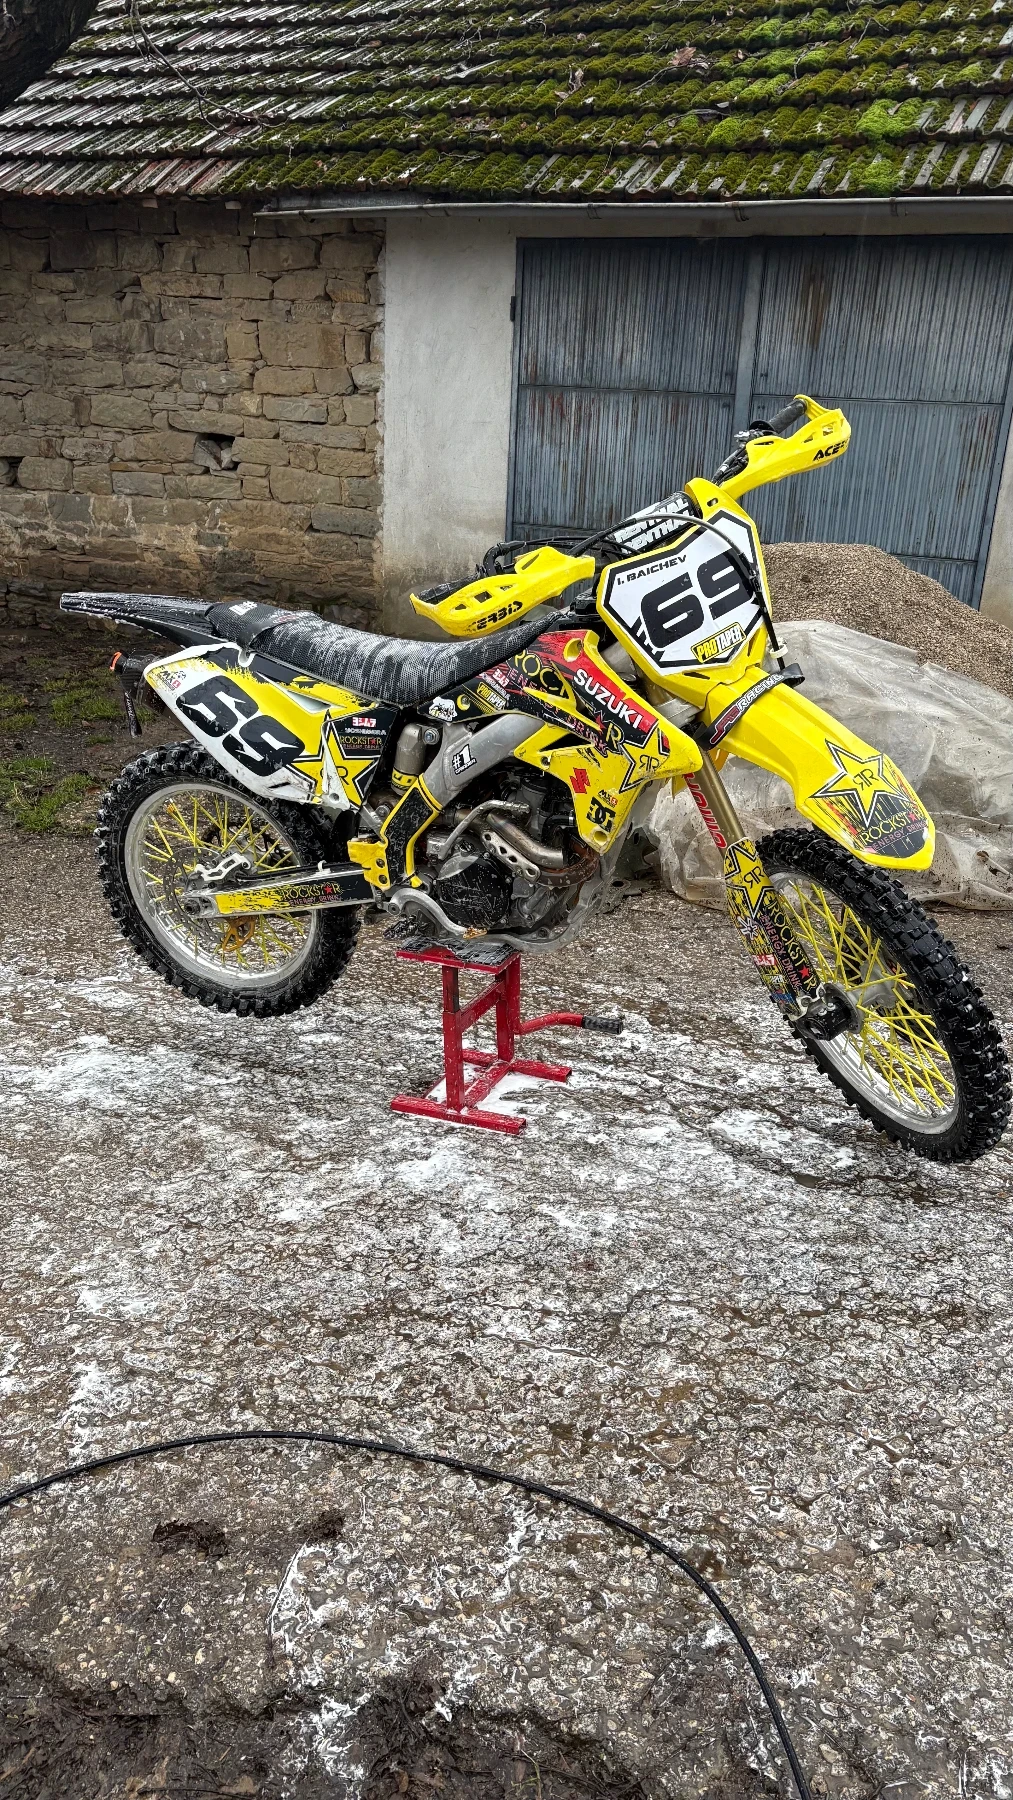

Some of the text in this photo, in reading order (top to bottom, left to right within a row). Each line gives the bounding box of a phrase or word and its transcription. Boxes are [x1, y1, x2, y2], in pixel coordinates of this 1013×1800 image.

[627, 554, 687, 582] BAICHEV
[640, 548, 754, 649] 69
[696, 626, 744, 662] PROTAPER
[175, 674, 306, 777] 69
[573, 668, 644, 729] SUZUKI
[873, 828, 905, 850] ENERGY
[760, 913, 786, 956] ENERGY
[781, 955, 803, 992] DRINK
